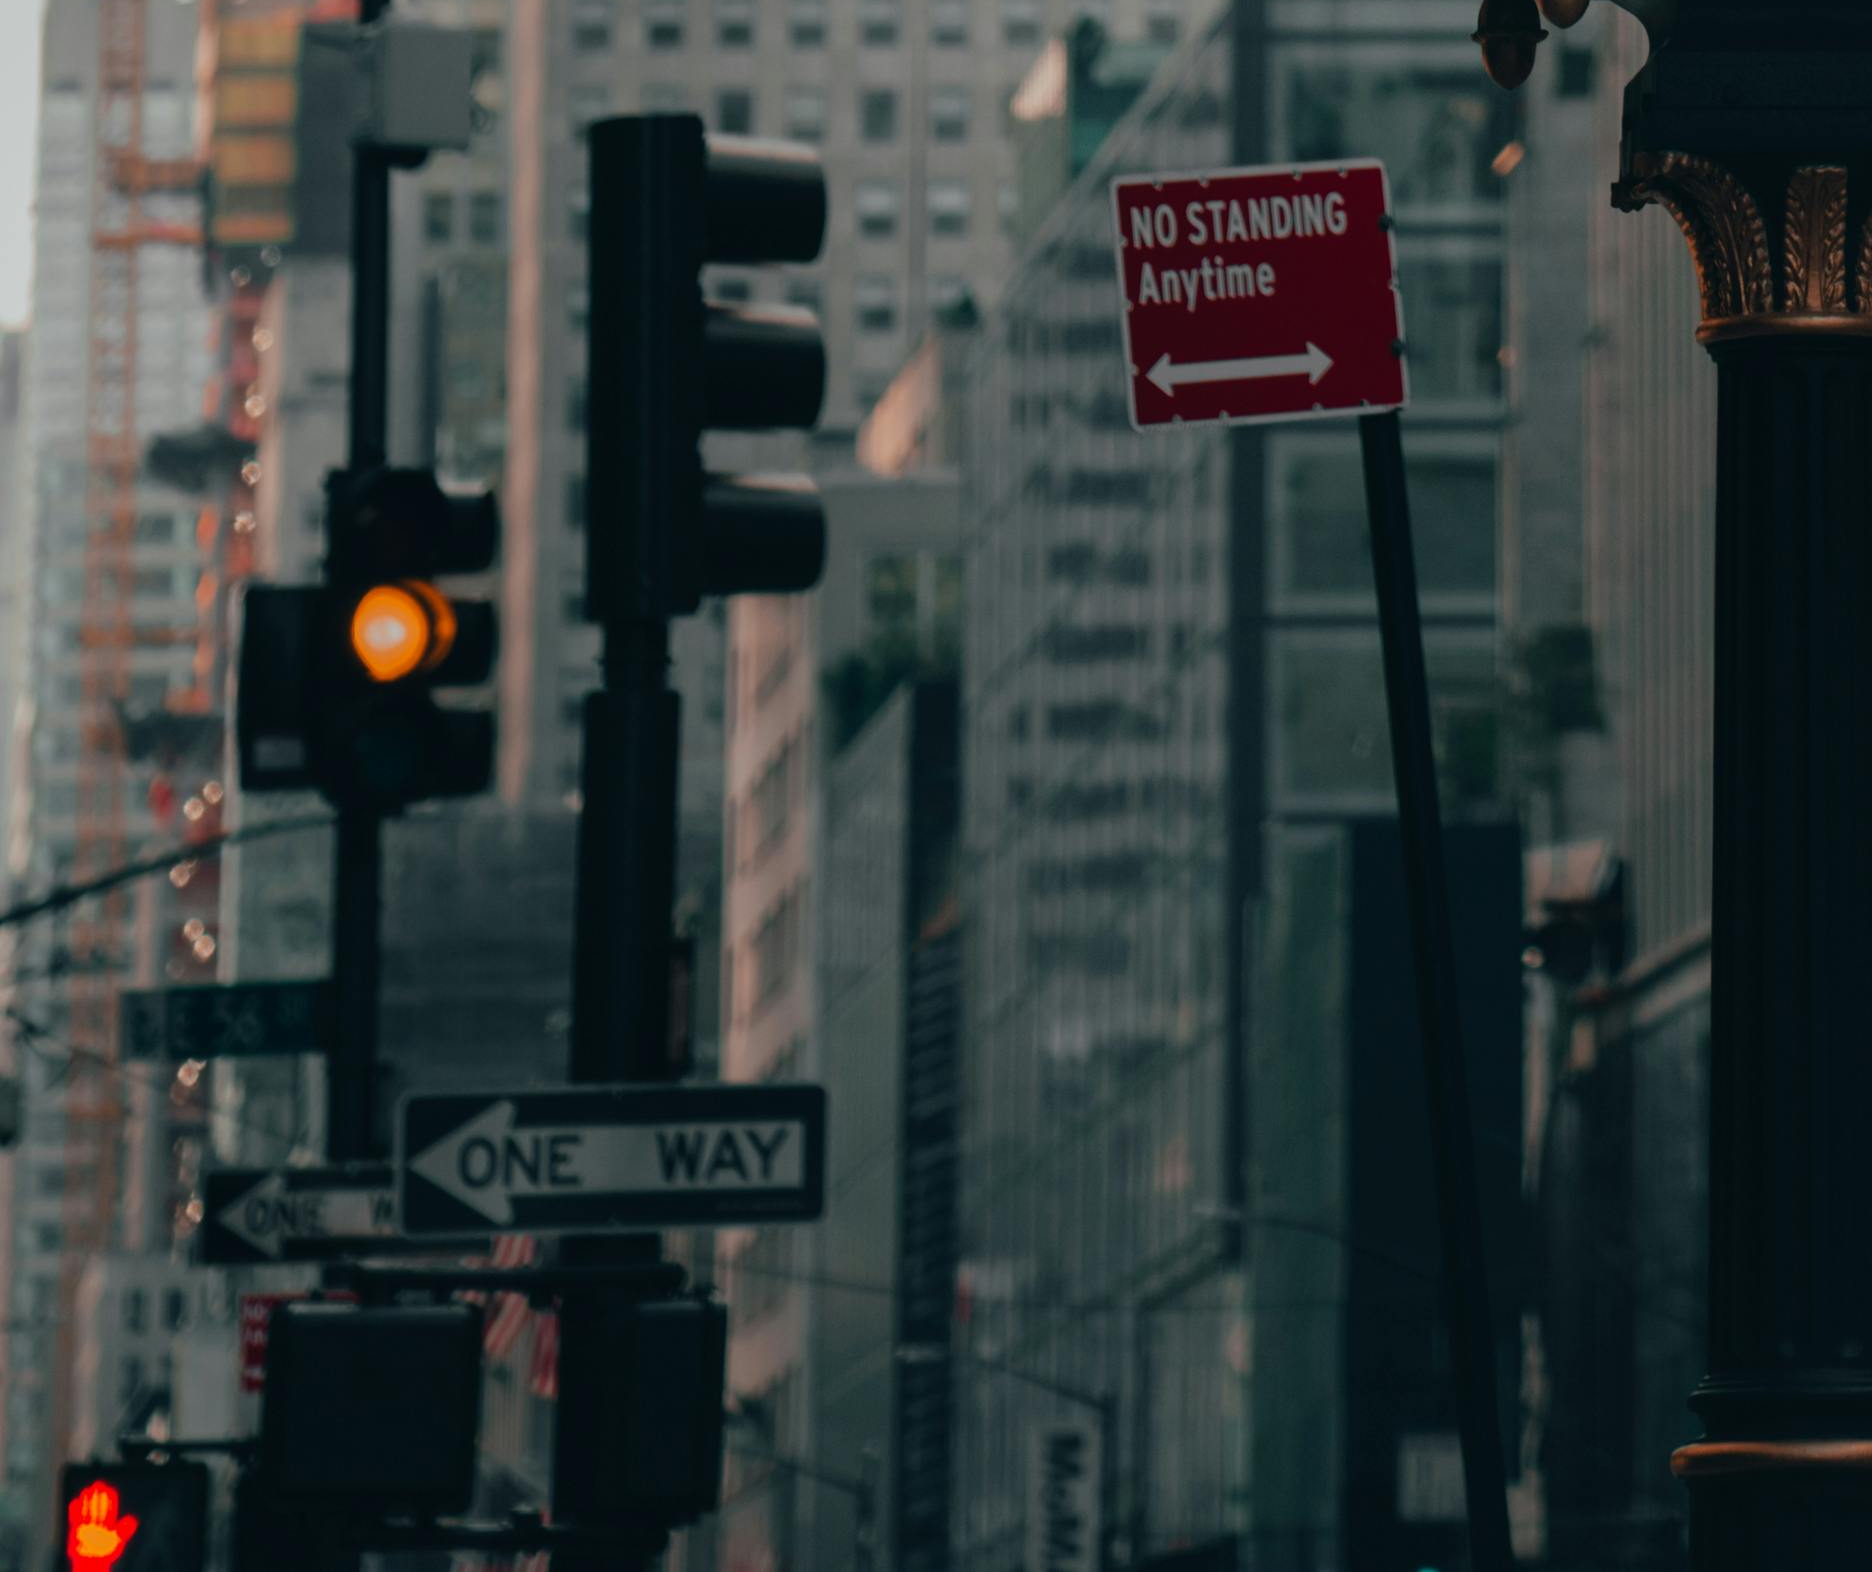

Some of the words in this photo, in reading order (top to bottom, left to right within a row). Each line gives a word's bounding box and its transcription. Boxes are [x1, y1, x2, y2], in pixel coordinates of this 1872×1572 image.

[1129, 203, 1178, 251] NO
[1185, 191, 1349, 247] STANDING
[1138, 254, 1277, 313] Anytime
[456, 1134, 582, 1190] ONE
[655, 1128, 790, 1186] WAY
[243, 1191, 326, 1239] ONE
